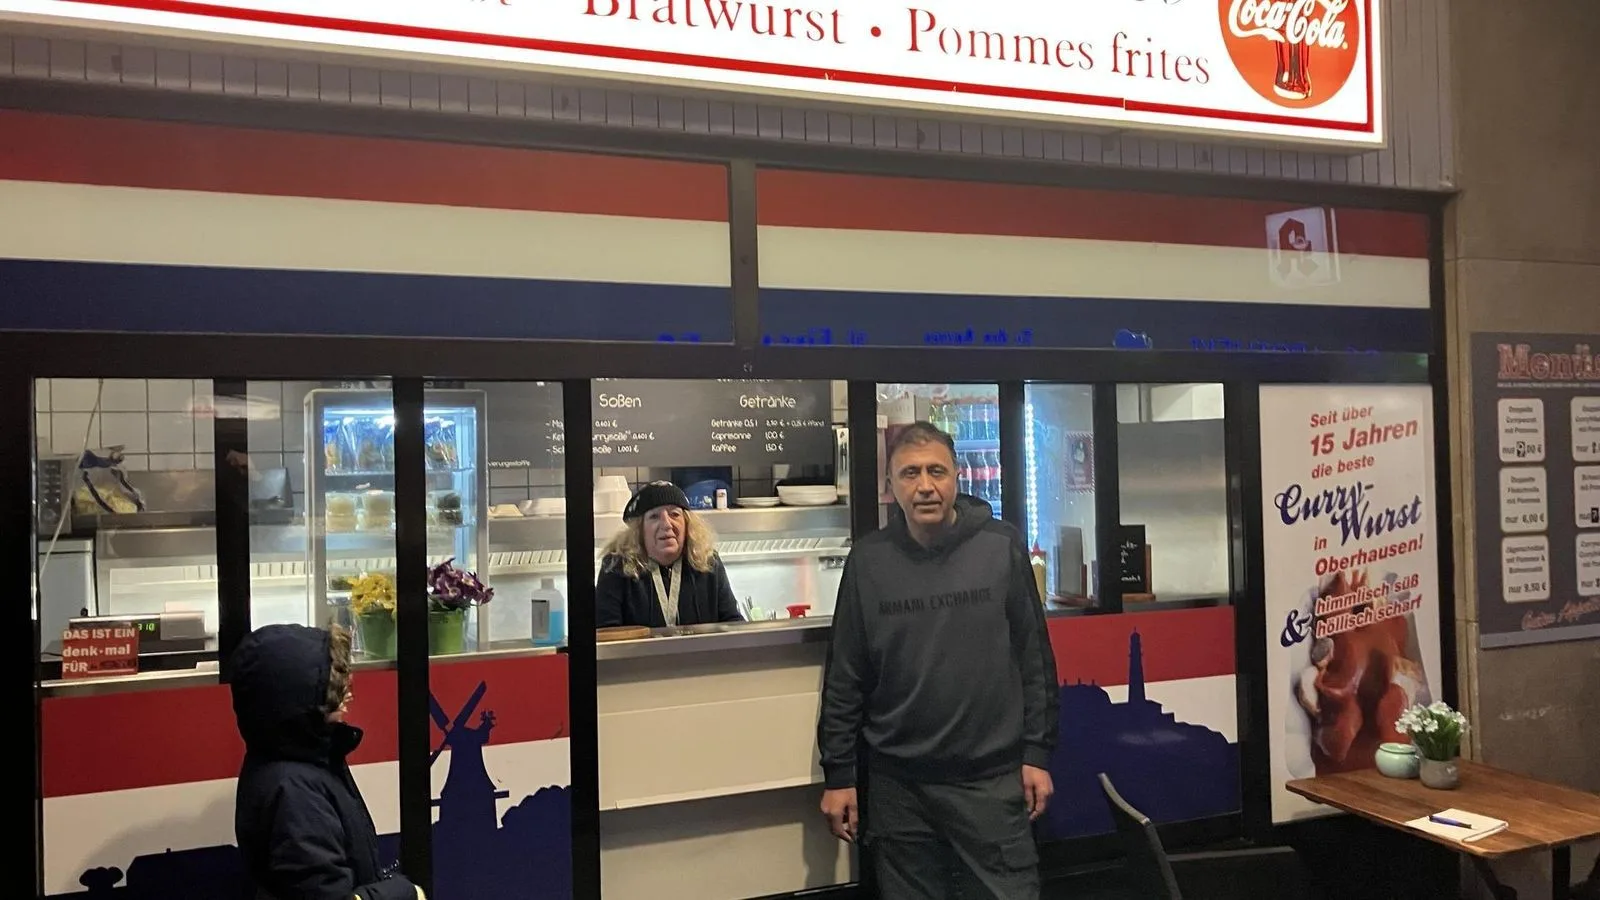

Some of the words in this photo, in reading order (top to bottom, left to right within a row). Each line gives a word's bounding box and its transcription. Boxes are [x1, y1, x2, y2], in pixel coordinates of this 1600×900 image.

[1228, 0, 1348, 49] Coca-Cola
[906, 8, 1094, 71] Pommes
[1111, 31, 1211, 85] frites
[599, 393, 643, 408] Soßen
[739, 395, 797, 409] Getränke
[1310, 411, 1338, 429] Seit
[1342, 405, 1375, 422] über
[711, 444, 737, 453] Kaffee
[1310, 432, 1335, 457] 15
[1342, 419, 1419, 451] Jahren
[1311, 463, 1333, 480] die
[1337, 455, 1375, 474] beste
[1274, 481, 1374, 526] Curry-
[1331, 495, 1422, 546] Wurst
[1314, 536, 1328, 551] in
[1315, 533, 1425, 577] Oberhausen!
[929, 587, 991, 611] EXCHANGE
[1315, 582, 1390, 617] himmlisch
[1394, 573, 1420, 594] süß
[1280, 608, 1314, 648] &
[1315, 608, 1375, 639] höllisch
[1376, 594, 1423, 621] scharf
[63, 629, 89, 640] DAS
[92, 628, 111, 639] IST
[115, 627, 136, 639] EIN
[62, 660, 88, 673] FÜR
